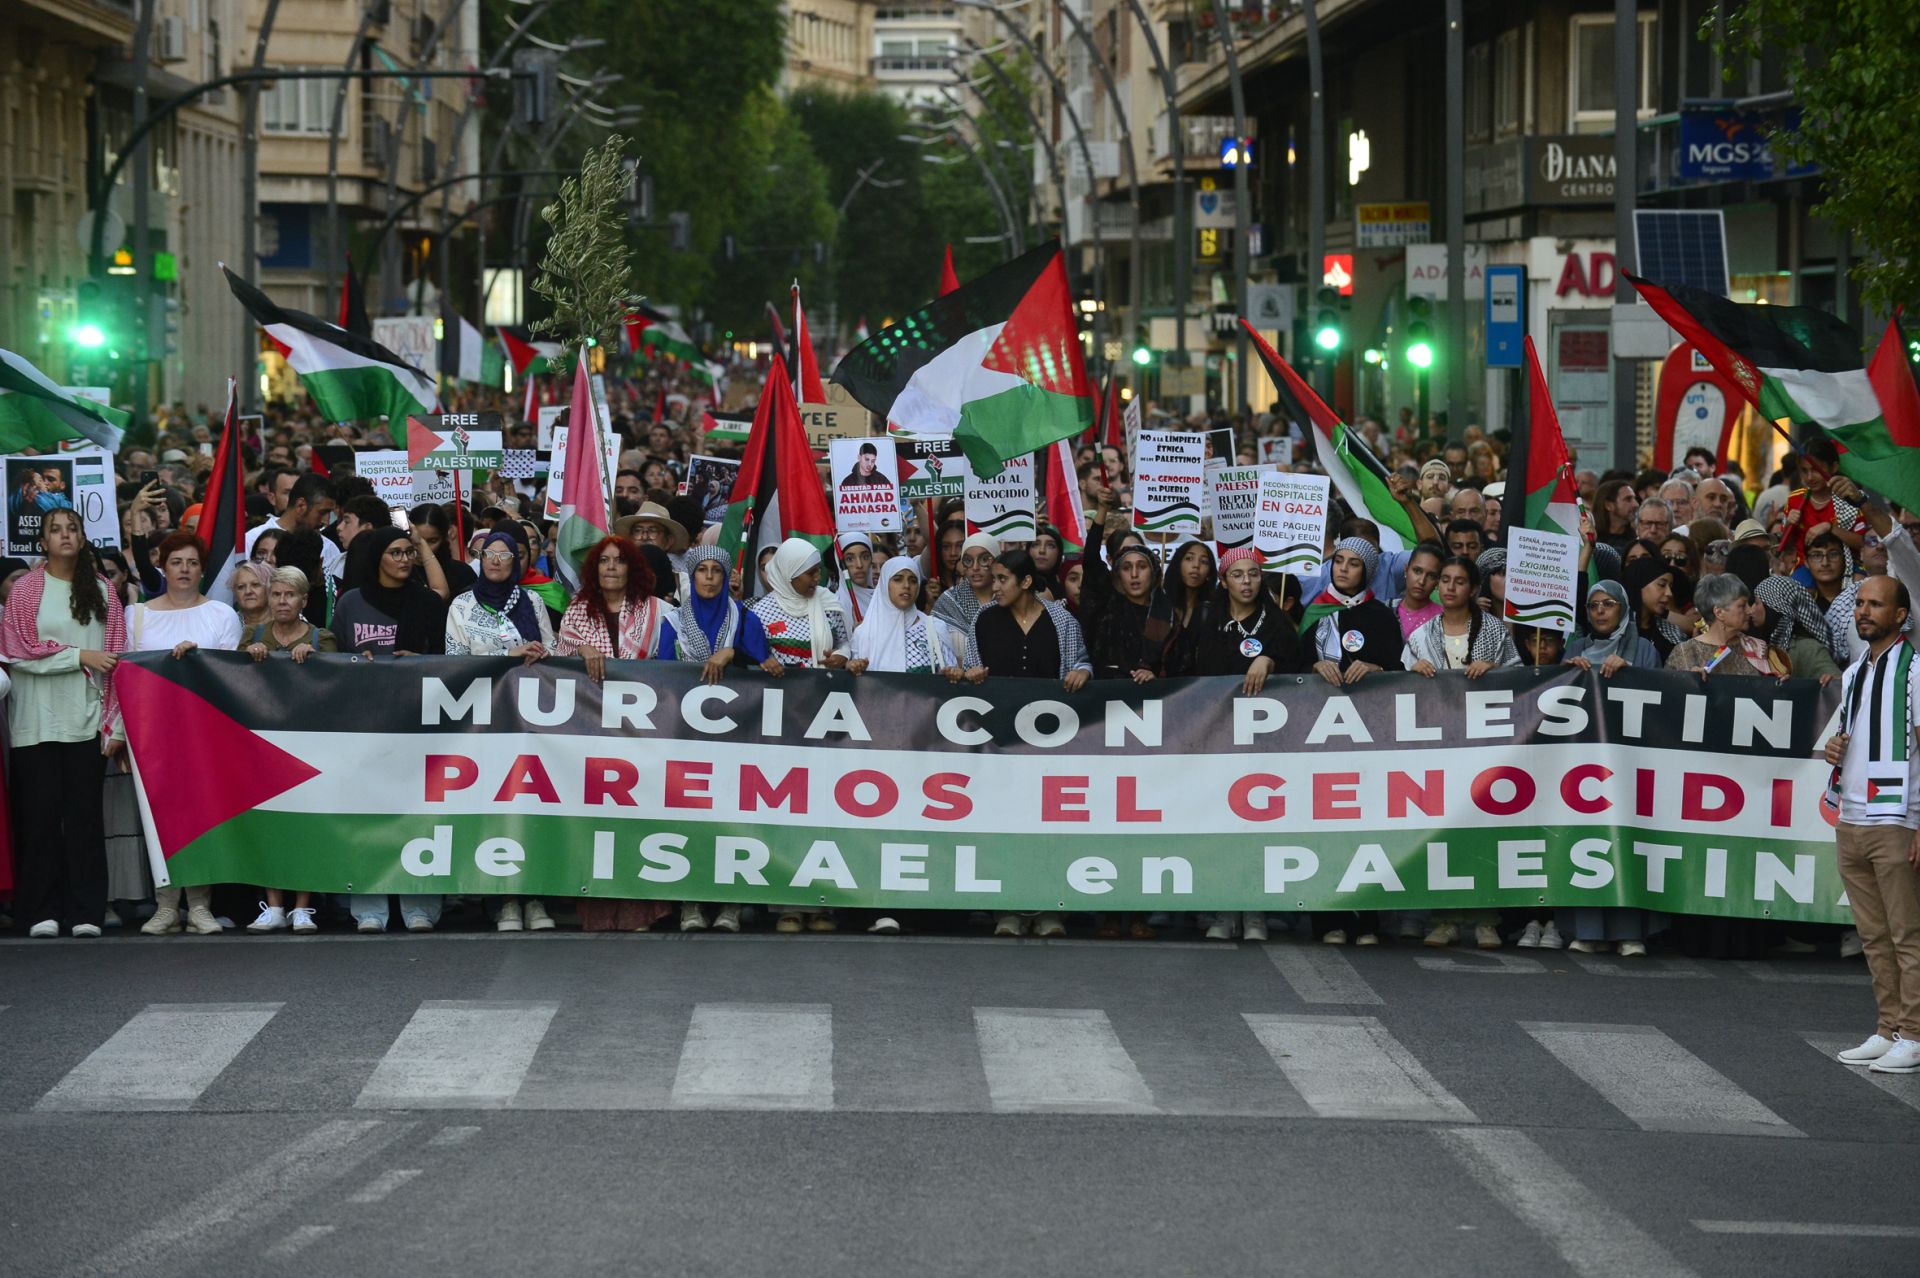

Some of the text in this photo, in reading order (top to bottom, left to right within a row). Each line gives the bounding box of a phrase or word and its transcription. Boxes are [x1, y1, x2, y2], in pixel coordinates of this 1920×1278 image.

[1689, 143, 1749, 164] MGS
[1546, 143, 1617, 182] DIANA
[1561, 183, 1614, 197] CENTRO
[441, 414, 478, 426] FREE
[1140, 434, 1151, 442] NO
[1165, 435, 1202, 444] LIMPIEZA
[914, 440, 951, 454] FREE
[1157, 443, 1184, 453] ÉTNICA
[424, 456, 498, 468] PALESTINE
[1155, 455, 1202, 464] PALESTINOS
[382, 476, 413, 486] GAZA
[1009, 474, 1023, 484] AL
[1139, 474, 1150, 482] NO
[1158, 475, 1201, 484] GENOCIDIO
[1219, 470, 1258, 482] MURCI
[900, 481, 963, 497] PALESTIN
[1159, 485, 1190, 493] PUEBLO
[1215, 480, 1258, 492] PALESTI
[1263, 481, 1324, 492] RECONSTRUCCIÓN
[413, 490, 470, 502] GENOCIDO
[840, 492, 894, 504] AHMAD
[968, 488, 1030, 500] GENOCIDIO
[1148, 494, 1190, 503] PALESTINO
[1218, 493, 1258, 505] RUPTU
[1263, 489, 1323, 501] HOSPITALES
[839, 504, 898, 514] MANASRA
[993, 504, 1007, 514] YA
[1220, 501, 1255, 511] RELACIO
[1262, 500, 1323, 516] EN GAZA
[19, 515, 41, 528] ASESI
[1217, 512, 1251, 520] EMBARGO
[1222, 521, 1255, 531] SANCIO
[1258, 520, 1321, 532] QUE PAGUEN
[1259, 530, 1289, 539] ISRAEL
[1297, 533, 1321, 542] EEUU
[10, 542, 32, 552] Israel
[1525, 551, 1542, 559] militar
[1519, 560, 1561, 573] EXIGIMOS
[1510, 567, 1571, 581] GOBIERNO ESPAÑOL
[1510, 577, 1570, 592] EMBARGO INTEGRAL
[1520, 587, 1541, 596] ARMAS
[1546, 591, 1568, 600] ISRAEL
[353, 622, 398, 644] PALEST
[420, 676, 873, 742] MURCIA
[936, 694, 1163, 748] CON
[424, 753, 973, 822] PAREMOS
[1041, 774, 1162, 823] EL
[400, 824, 526, 878] de
[592, 829, 1003, 894] ISRAEL
[1066, 855, 1193, 895] en
